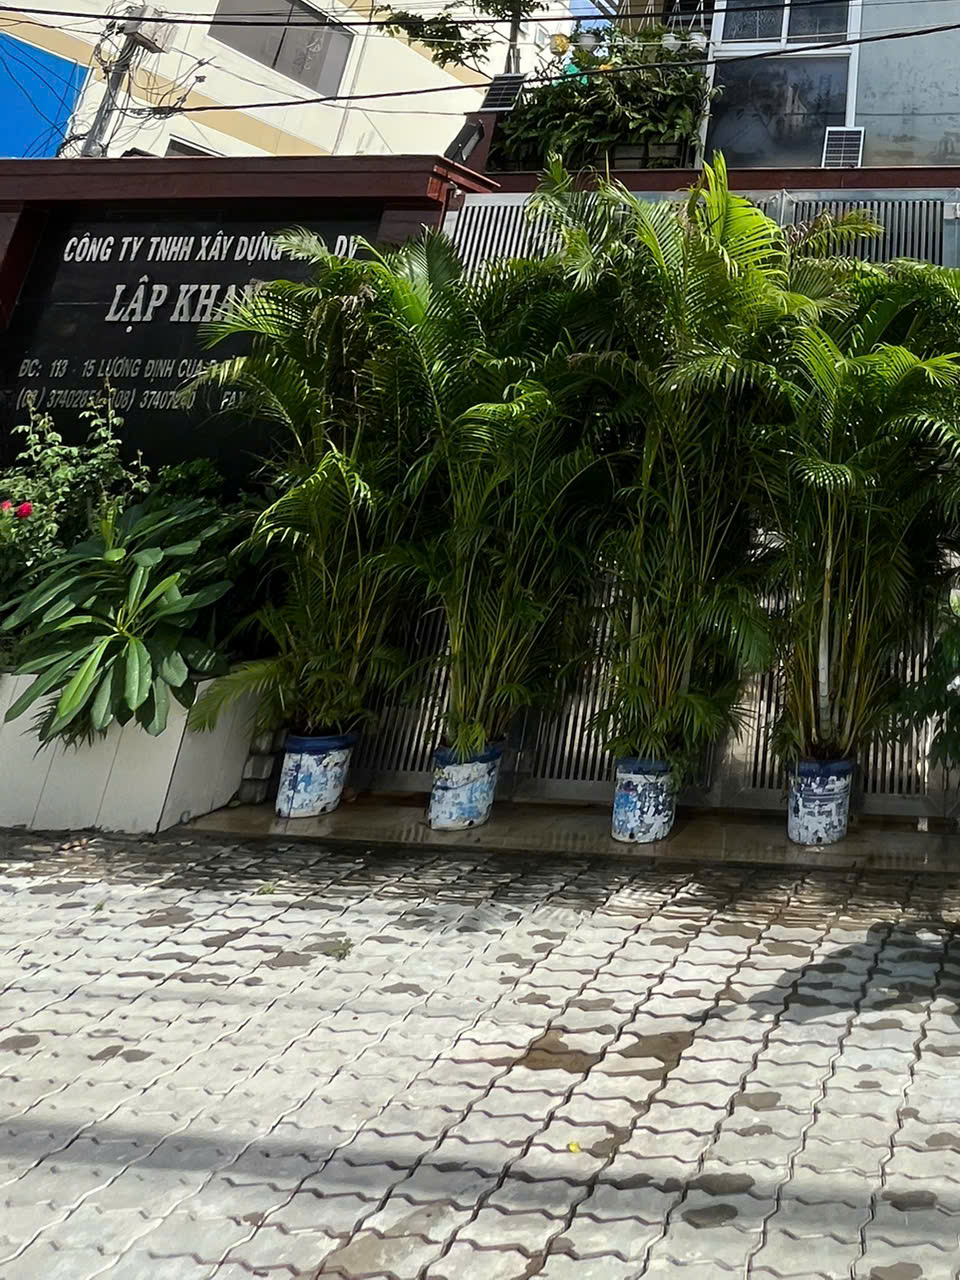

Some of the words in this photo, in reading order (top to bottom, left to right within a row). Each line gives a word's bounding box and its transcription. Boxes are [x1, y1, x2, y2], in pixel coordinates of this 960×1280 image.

[63, 232, 115, 262] CÔNG
[118, 236, 145, 261] TY
[147, 236, 195, 261] TNHH
[195, 230, 235, 261] XÂY
[104, 274, 168, 333] LẬP
[18, 358, 42, 377] ĐC:
[49, 359, 69, 377] 113
[82, 359, 97, 377] 15
